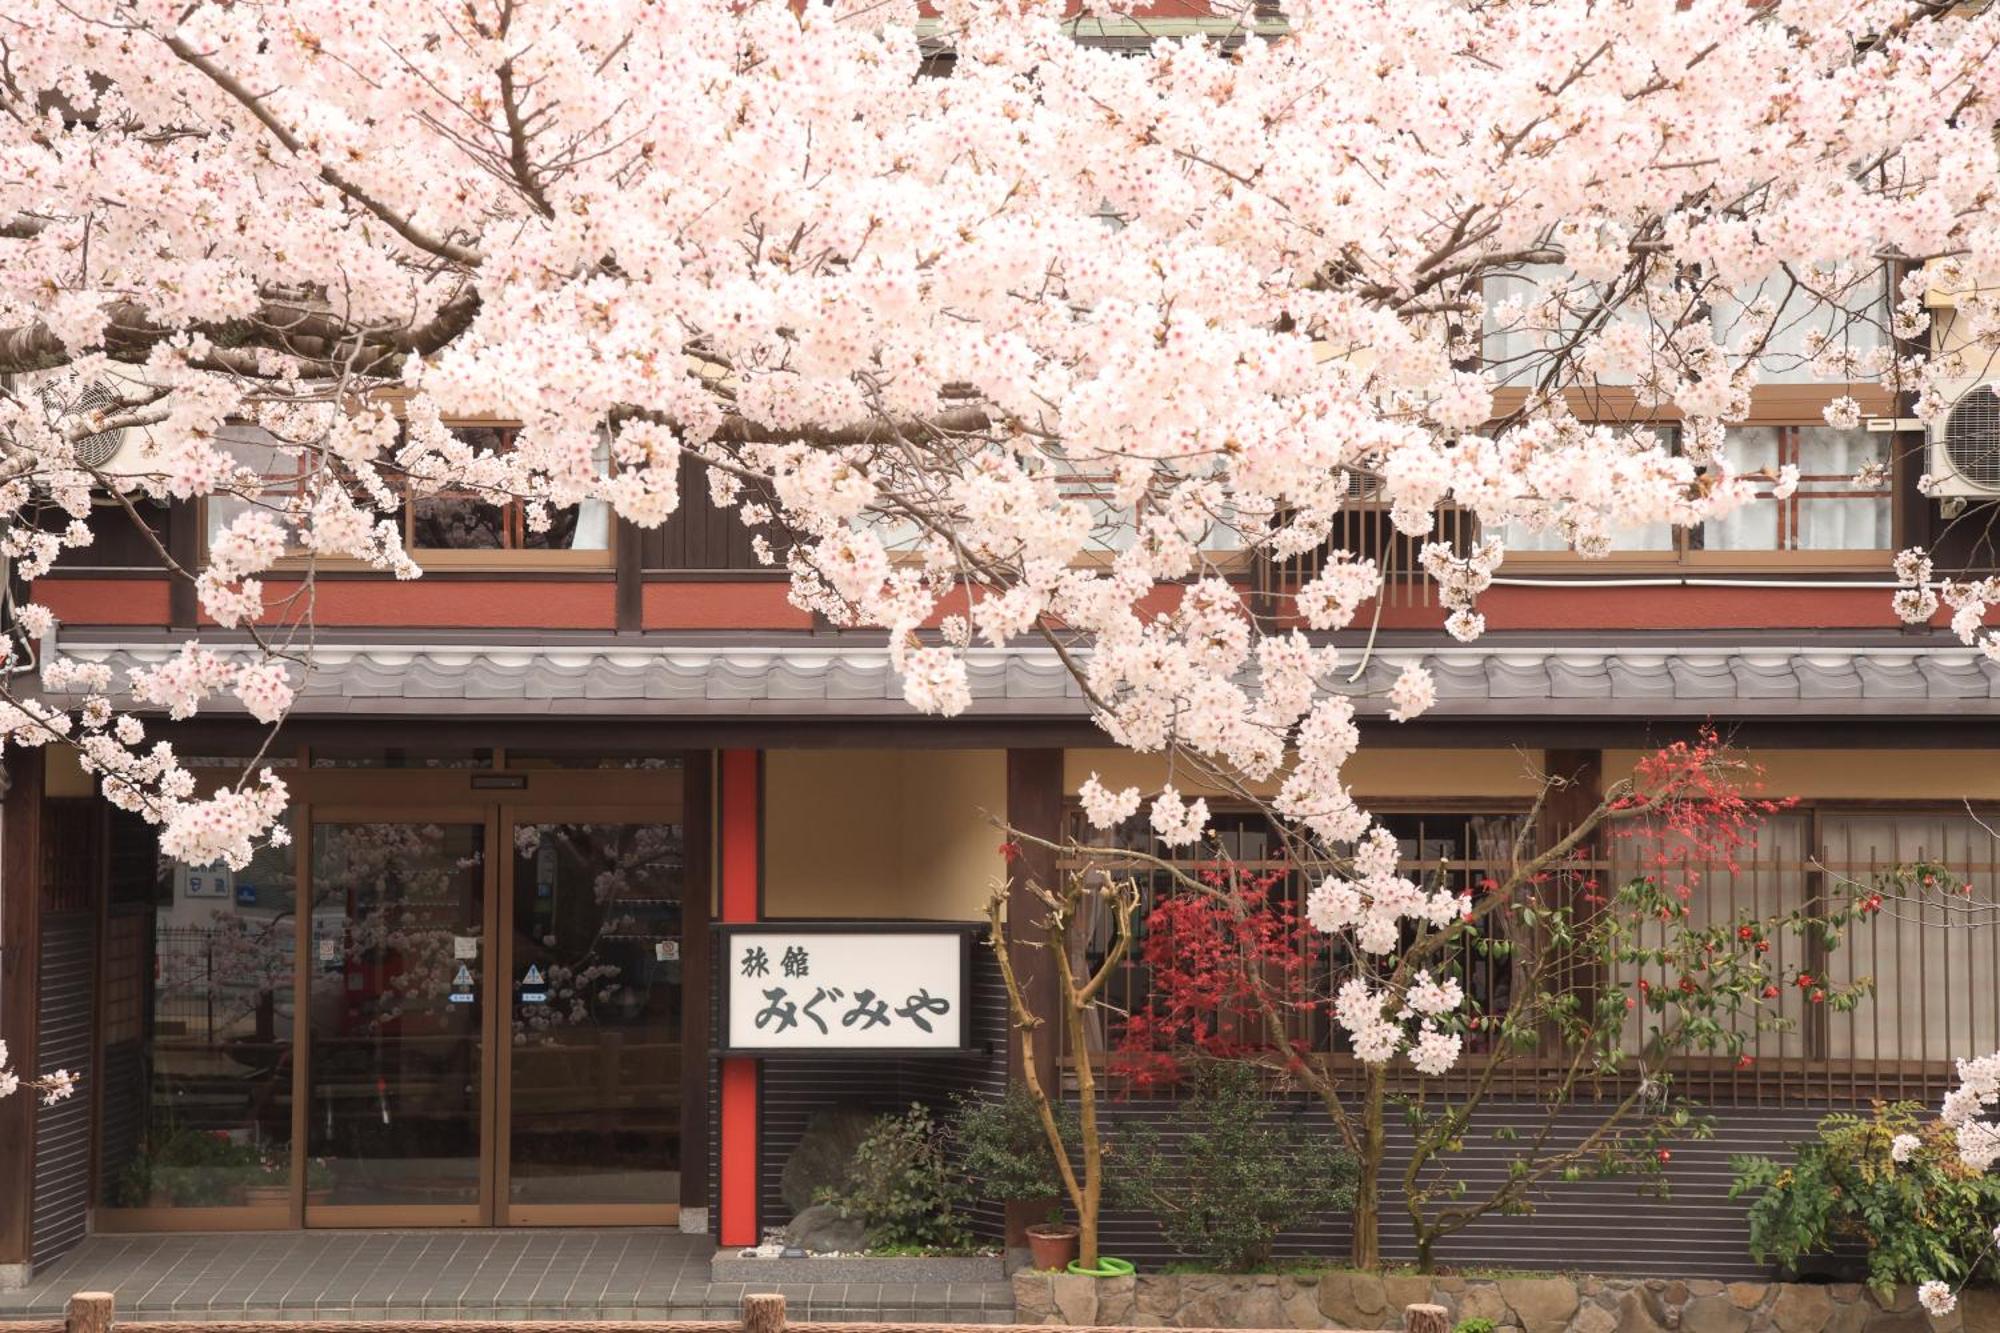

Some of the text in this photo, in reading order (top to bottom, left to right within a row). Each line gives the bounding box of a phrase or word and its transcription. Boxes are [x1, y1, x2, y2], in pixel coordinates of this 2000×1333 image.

[741, 946, 809, 978] 旅館
[755, 987, 950, 1035] みぐみや
